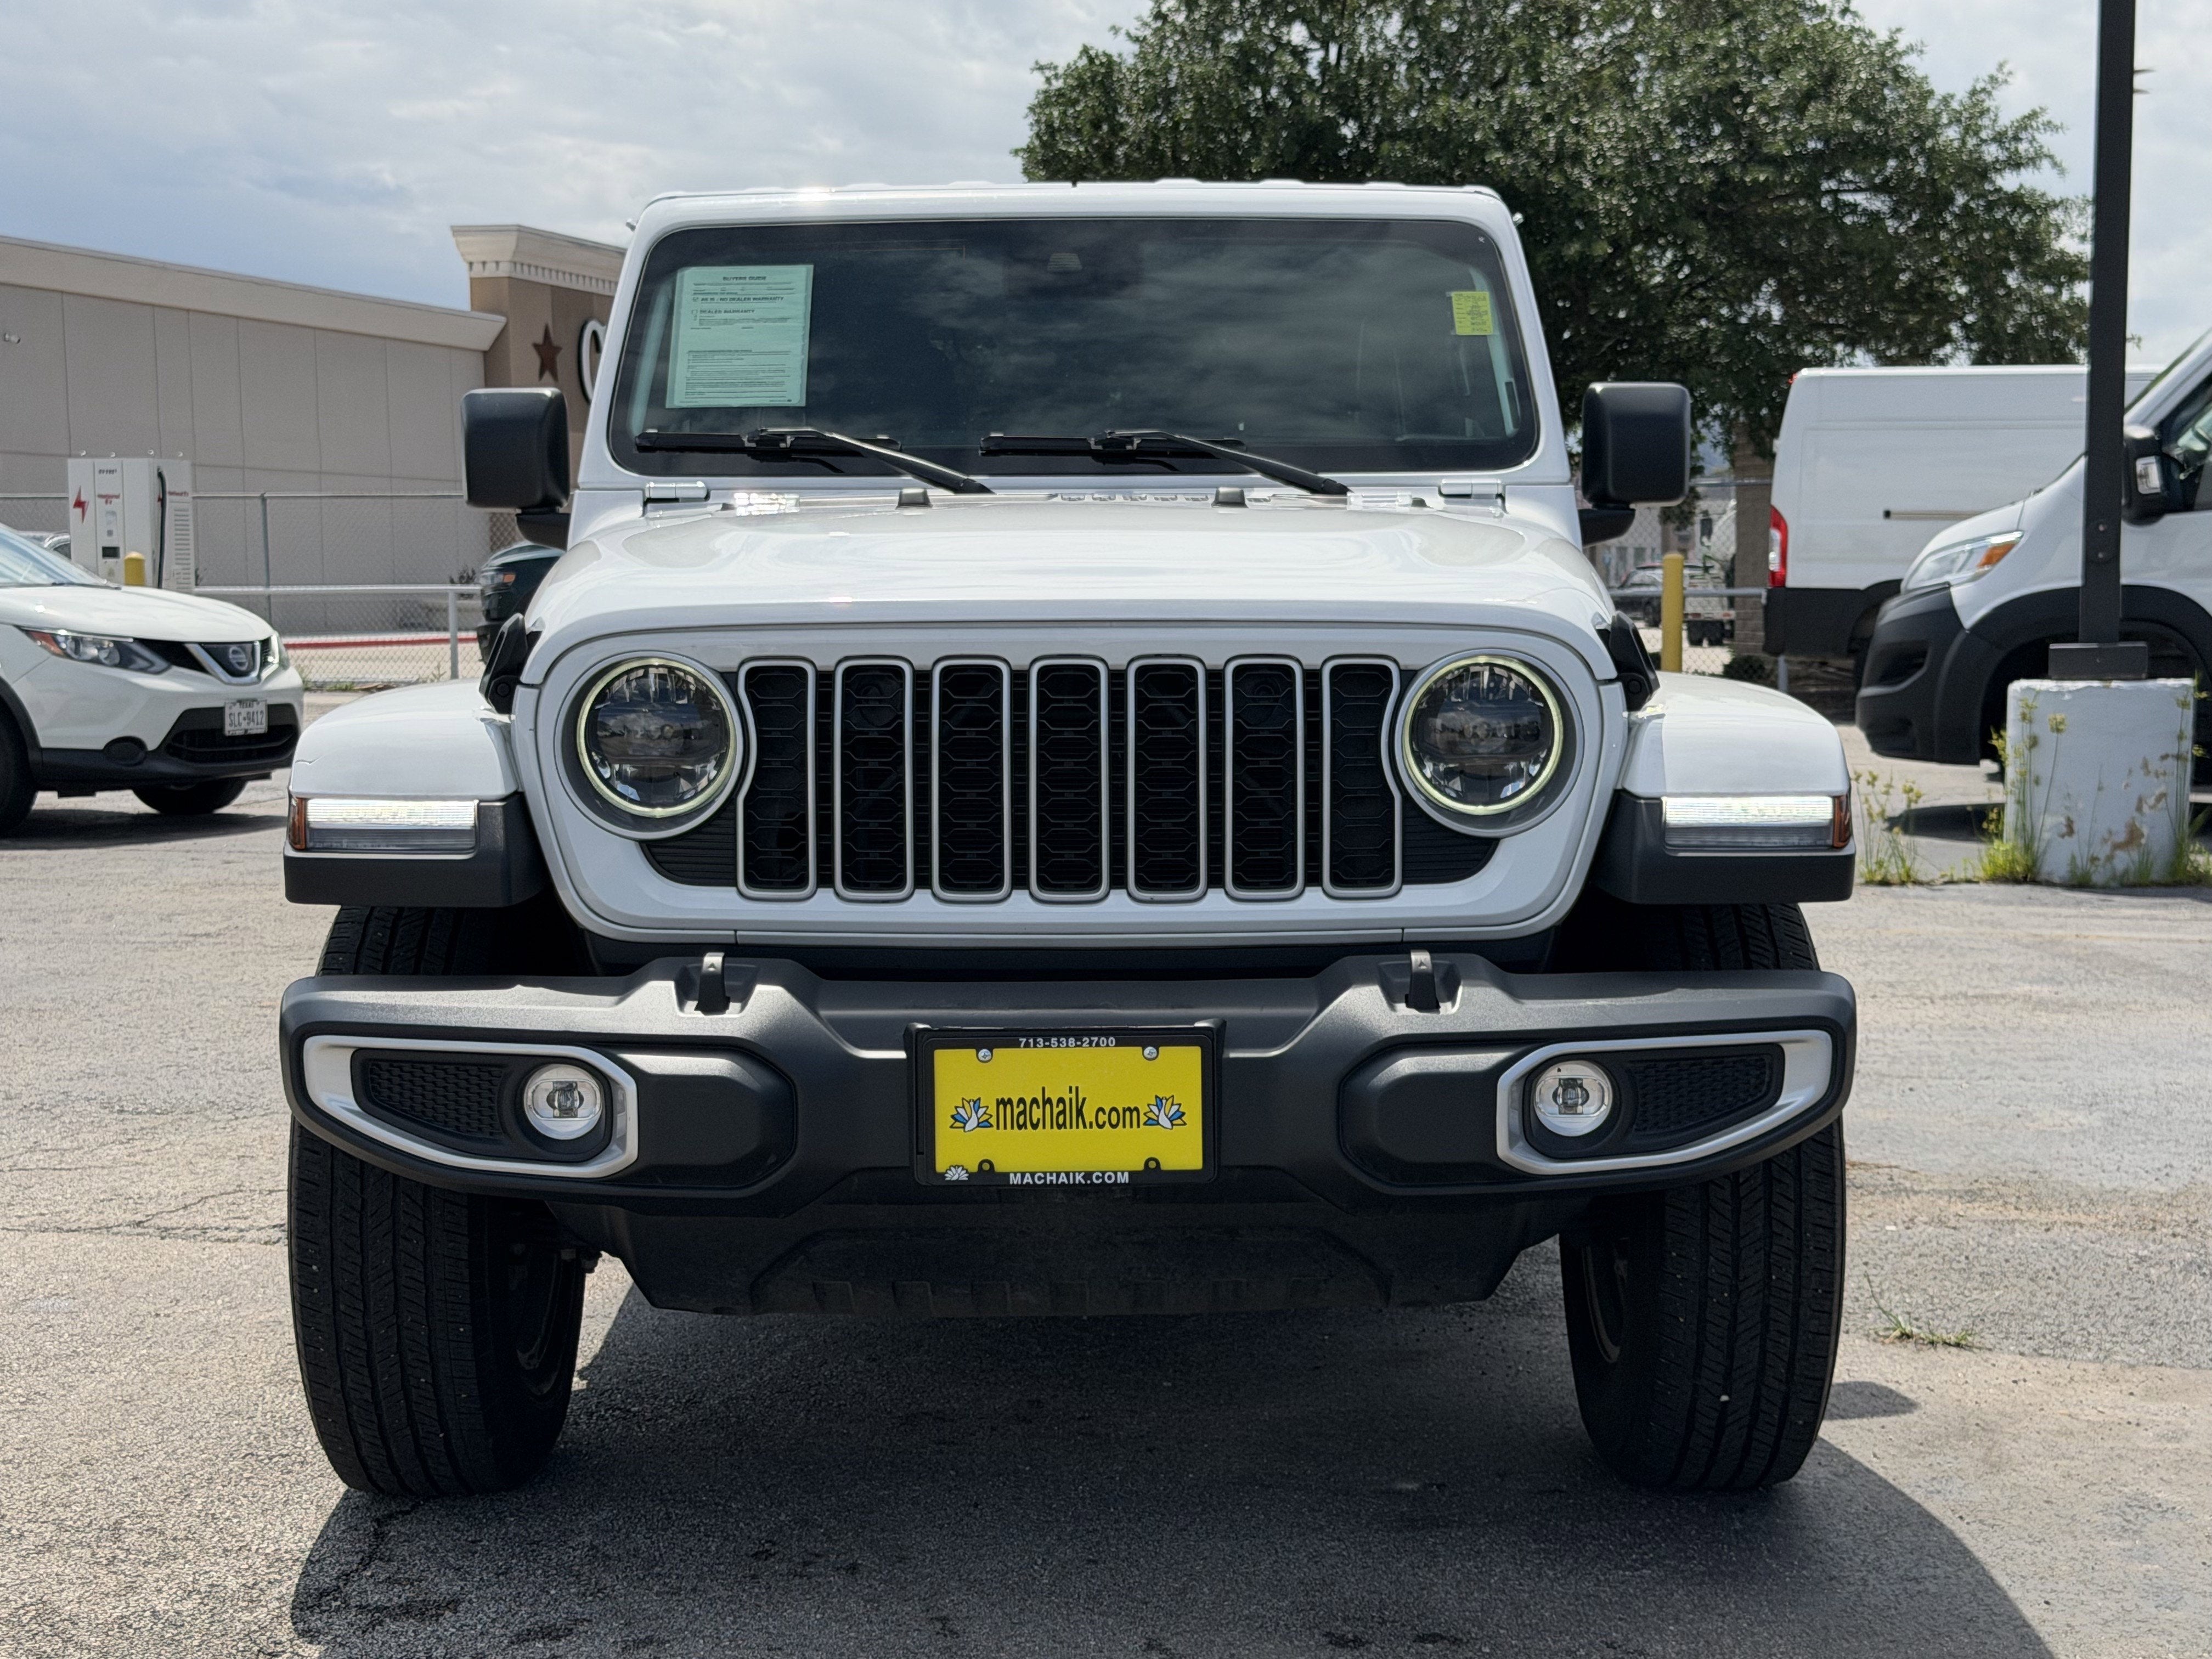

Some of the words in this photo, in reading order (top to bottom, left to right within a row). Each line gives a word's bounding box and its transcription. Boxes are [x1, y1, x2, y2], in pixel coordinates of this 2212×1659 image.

[1019, 1037, 1116, 1048] 713-538-2700
[995, 1086, 1141, 1130] machaik.com
[1009, 1172, 1130, 1185] MACHAIK.COM
